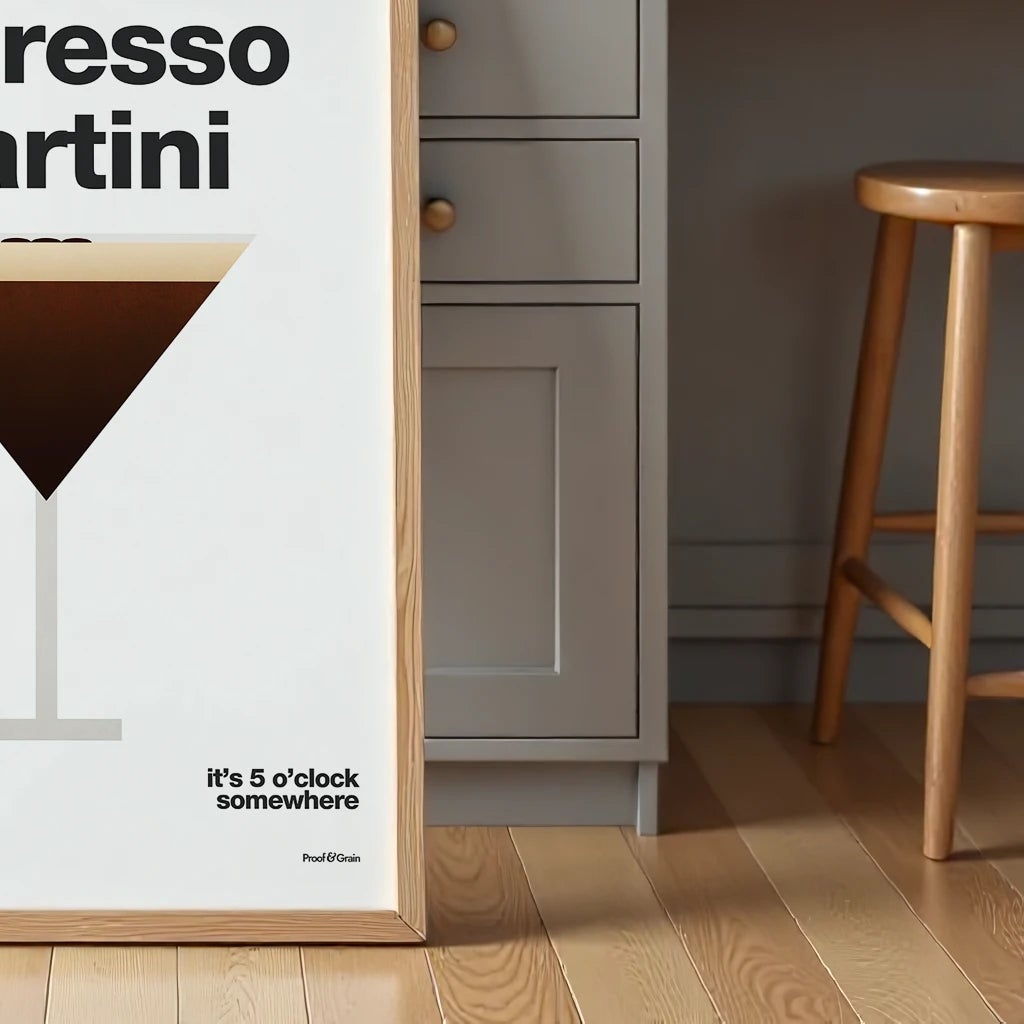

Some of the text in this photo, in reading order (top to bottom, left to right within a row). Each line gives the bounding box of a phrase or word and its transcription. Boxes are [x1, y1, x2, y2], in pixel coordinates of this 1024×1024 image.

[207, 768, 360, 788] it’s 5 o’clock
[216, 790, 360, 810] somewhere
